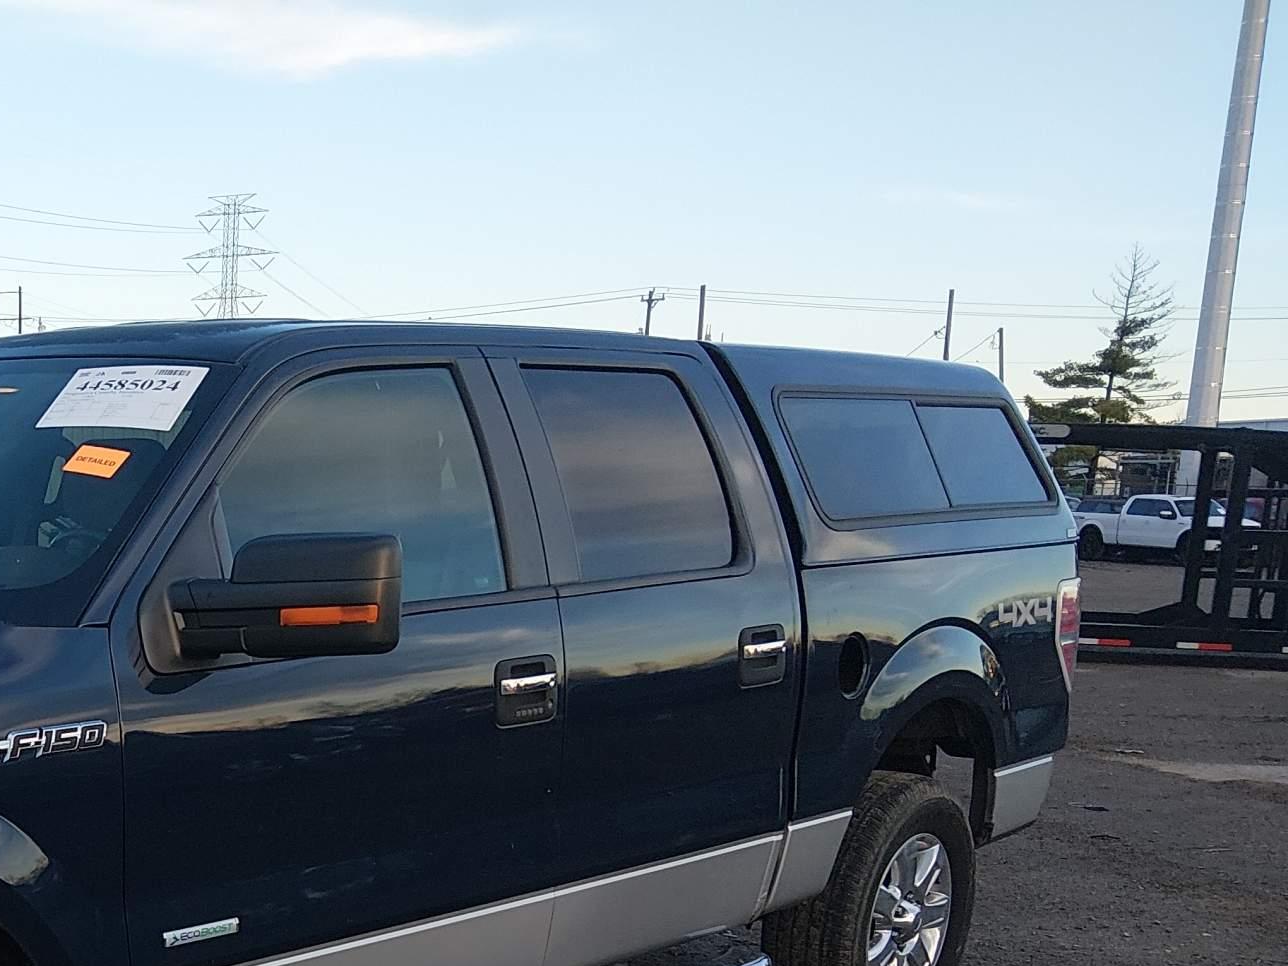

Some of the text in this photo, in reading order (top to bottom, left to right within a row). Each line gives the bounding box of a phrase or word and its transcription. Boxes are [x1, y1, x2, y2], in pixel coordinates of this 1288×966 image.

[76, 379, 182, 391] 44585024
[75, 455, 117, 467] DETAILED
[180, 922, 233, 941] ECOBOOST
